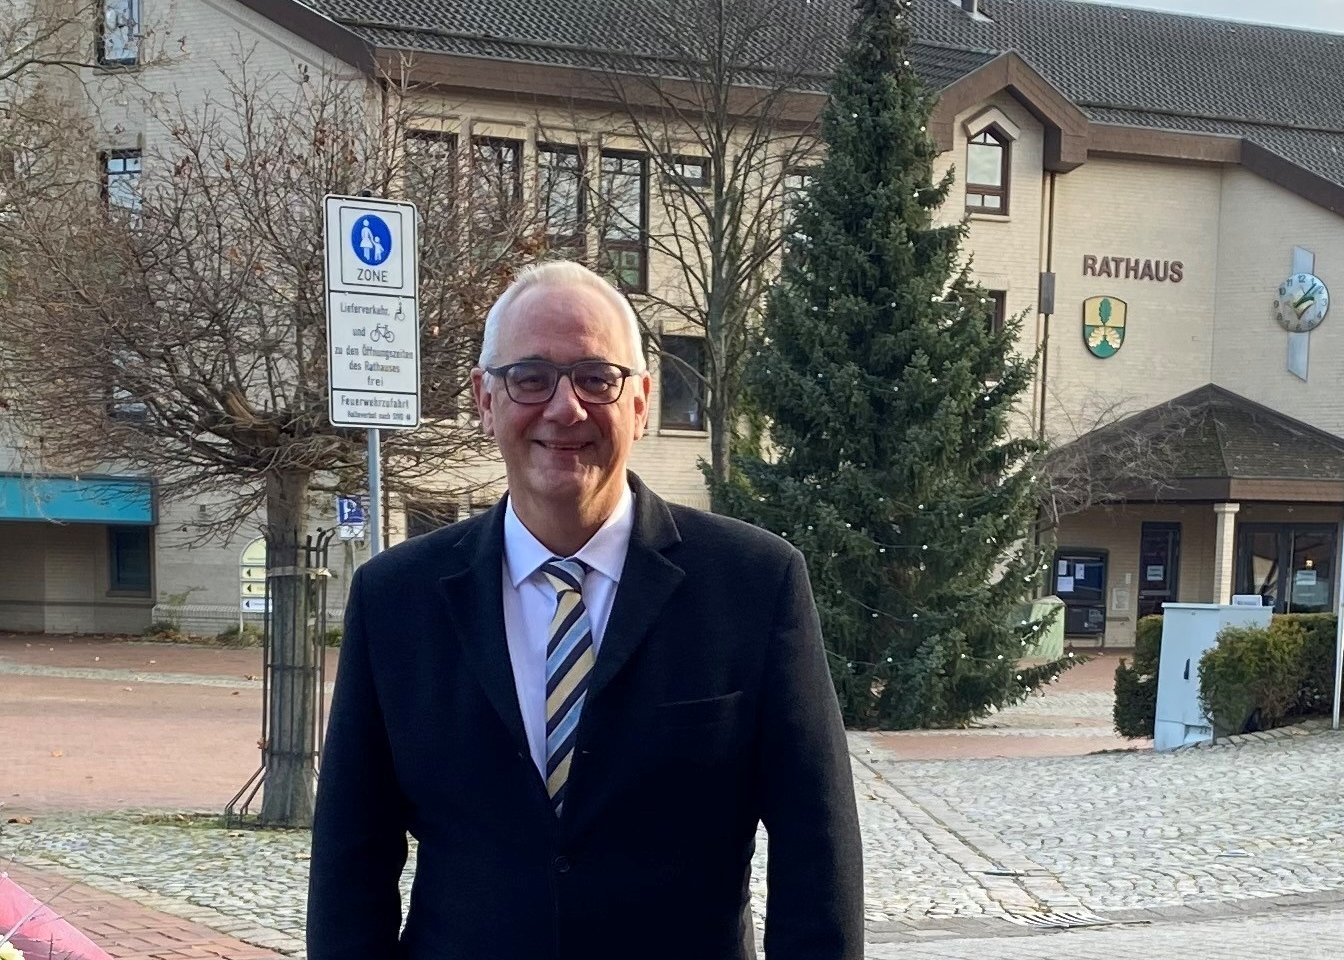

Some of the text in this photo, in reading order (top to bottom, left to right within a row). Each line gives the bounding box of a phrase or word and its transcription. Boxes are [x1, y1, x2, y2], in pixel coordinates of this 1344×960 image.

[357, 268, 389, 283] ZONE
[1083, 254, 1184, 284] RATHAUS
[352, 326, 366, 337] und
[335, 346, 343, 355] zu
[346, 345, 359, 356] den
[349, 360, 401, 374] des Rathauses
[367, 375, 384, 387] frei
[341, 394, 410, 410] Feuerwehrzufahrt
